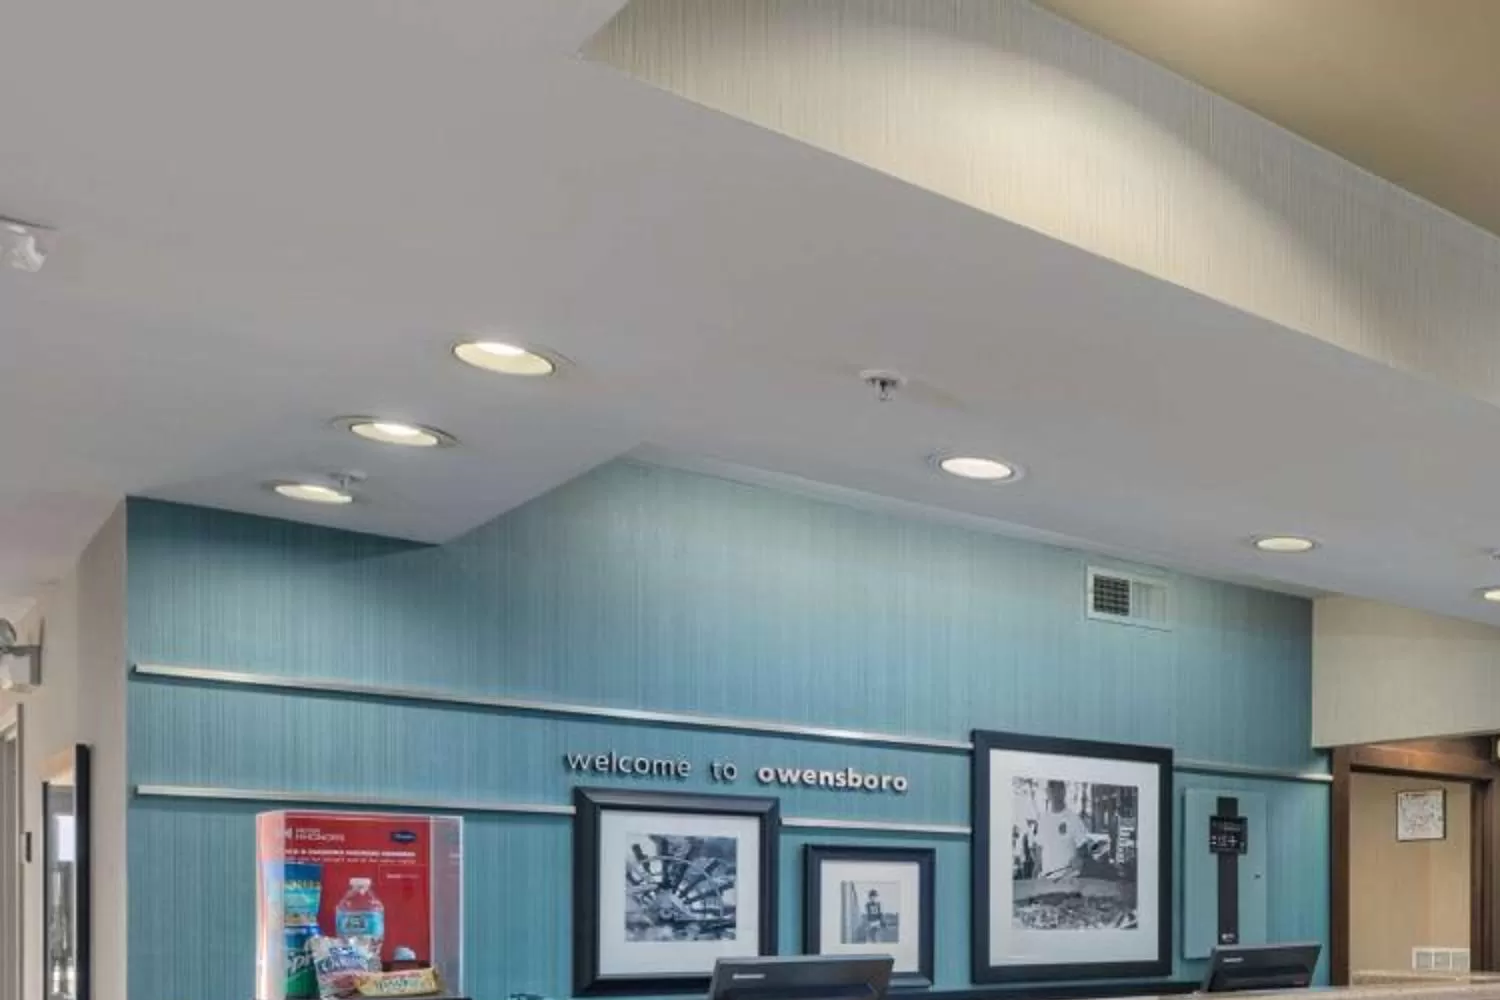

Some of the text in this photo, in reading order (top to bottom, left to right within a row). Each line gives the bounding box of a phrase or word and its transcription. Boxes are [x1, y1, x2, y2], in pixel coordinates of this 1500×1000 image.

[565, 750, 909, 791] welcome to owensboro
